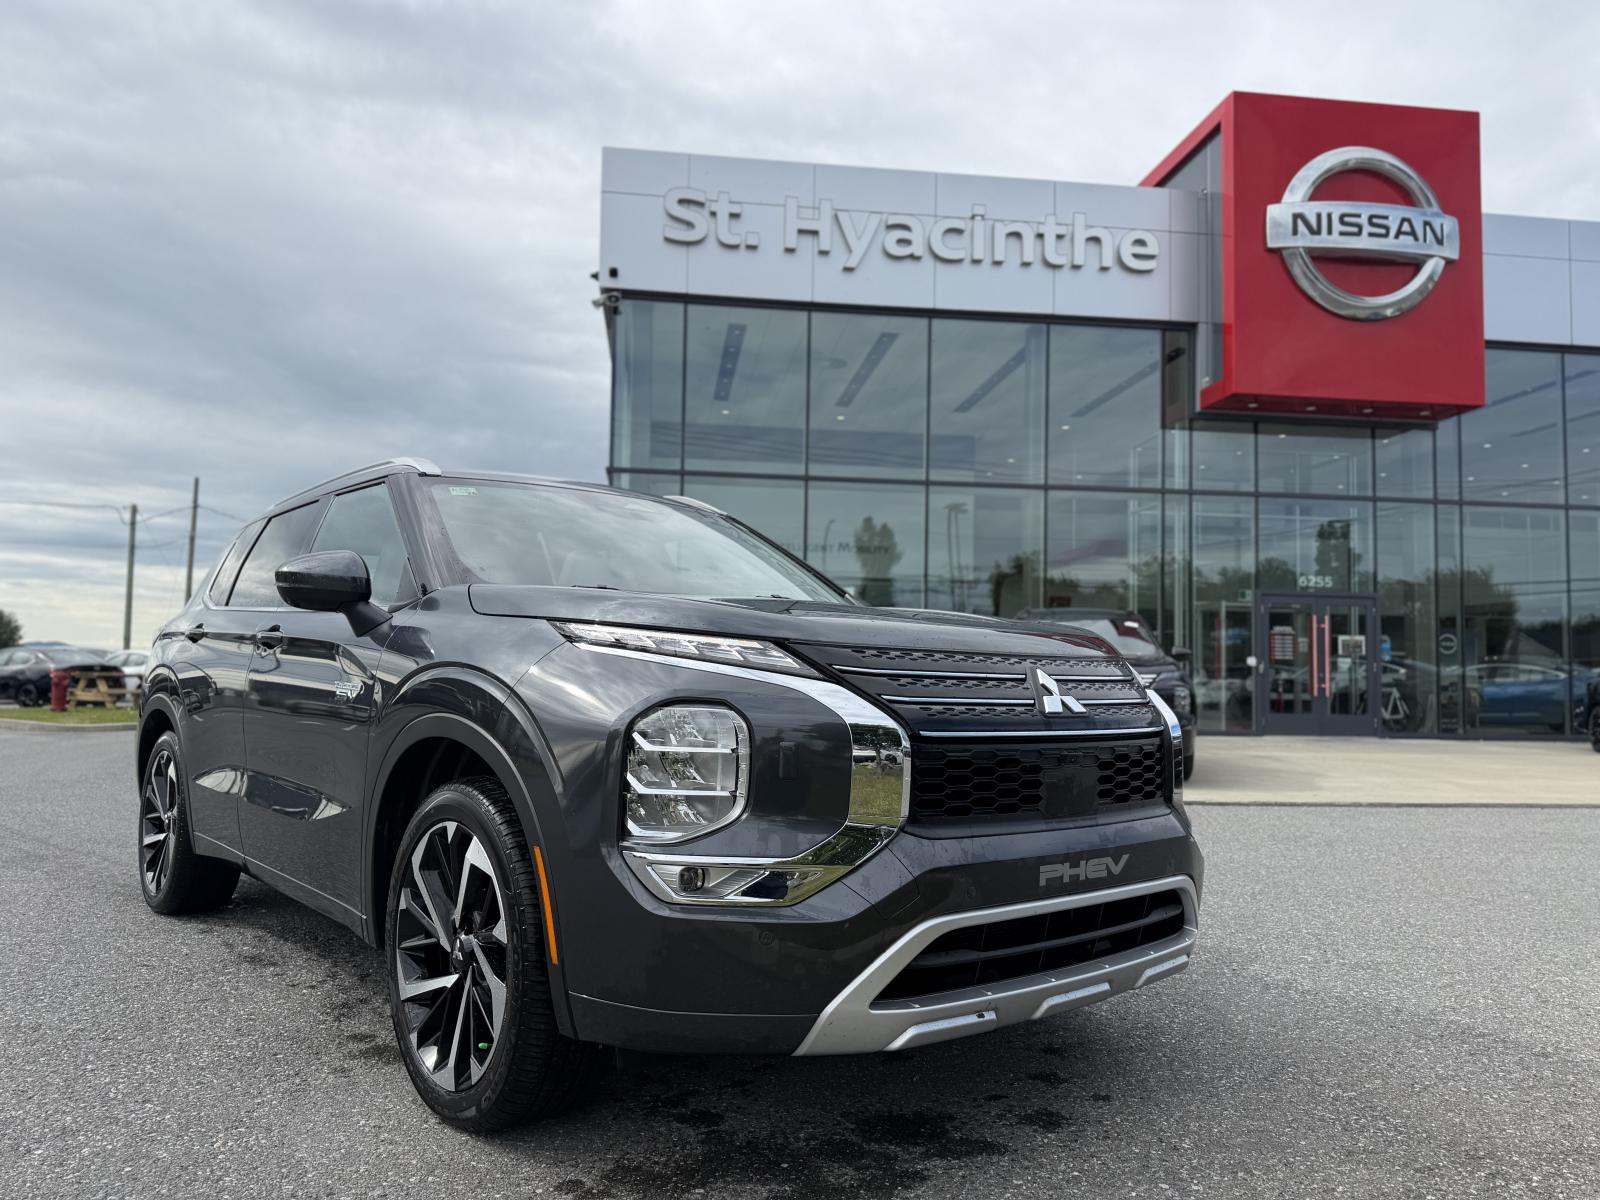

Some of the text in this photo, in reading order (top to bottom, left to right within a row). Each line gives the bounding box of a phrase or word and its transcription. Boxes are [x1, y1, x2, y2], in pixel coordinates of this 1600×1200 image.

[663, 186, 1160, 273] St. Hyacinthe
[1292, 212, 1444, 247] NISSAN
[1298, 575, 1333, 588] 6255
[1039, 854, 1129, 887] PHEV
